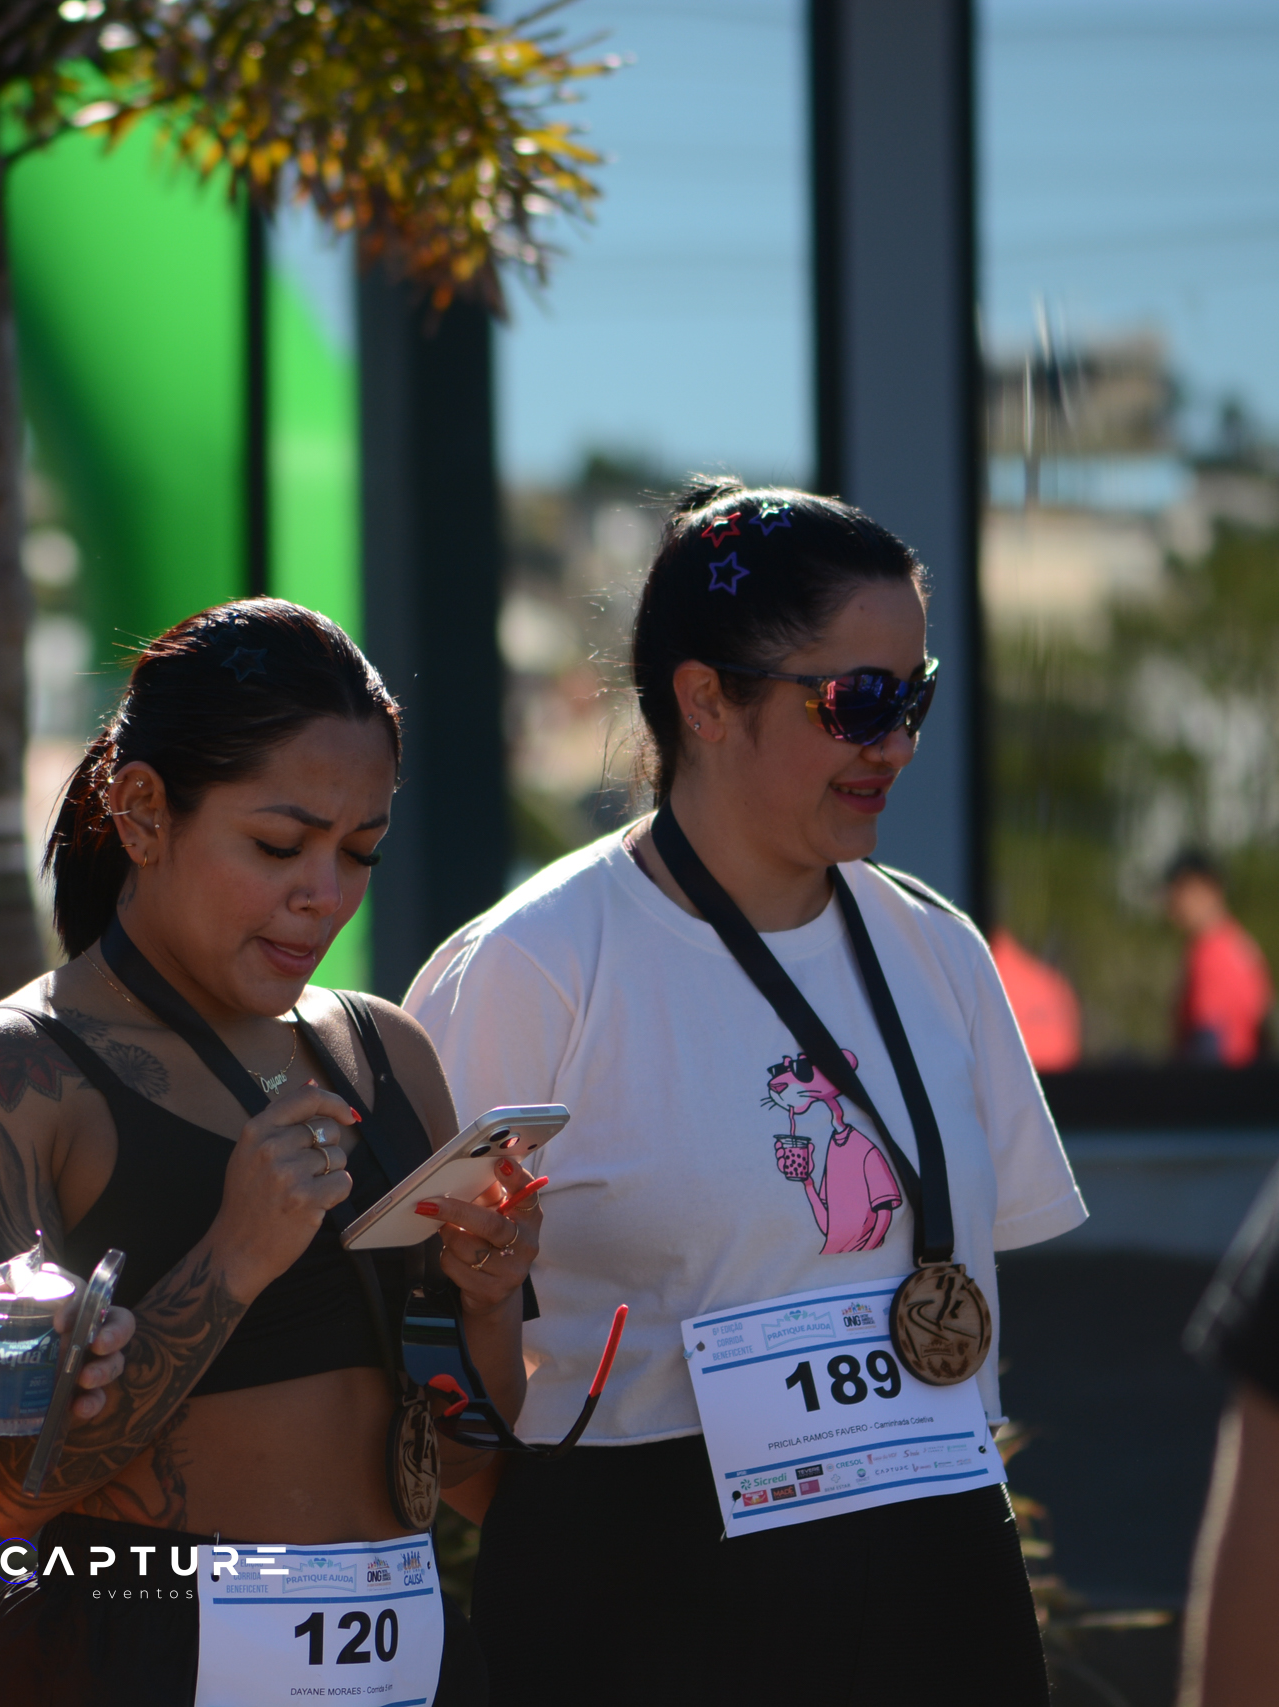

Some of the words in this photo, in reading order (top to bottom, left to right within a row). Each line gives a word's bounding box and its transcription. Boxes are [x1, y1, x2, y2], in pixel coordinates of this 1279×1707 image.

[843, 1314, 862, 1328] ONG
[767, 1324, 805, 1342] PRATIQUE
[806, 1323, 832, 1332] AJUDA
[717, 1335, 744, 1348] CORRIDA
[712, 1345, 754, 1361] BENEFICENTE
[785, 1349, 902, 1413] 189
[768, 1435, 801, 1450] PRICILA
[803, 1429, 834, 1444] RAMOS
[835, 1423, 868, 1438] FAVERO
[874, 1417, 909, 1430] Caminhada
[910, 1415, 934, 1426] Coletiva
[836, 1459, 863, 1469] CRESOL
[754, 1472, 787, 1487] Sicredi
[286, 1574, 327, 1585] PRATIQUE
[328, 1574, 354, 1584] AJUDA
[367, 1570, 381, 1583] ONG
[404, 1574, 424, 1586] CAUSA
[226, 1584, 269, 1593] BENEFICENTE
[294, 1608, 399, 1666] 120
[290, 1687, 325, 1696] DAYANE
[327, 1687, 361, 1696] MORAES
[367, 1684, 385, 1694] Corrida
